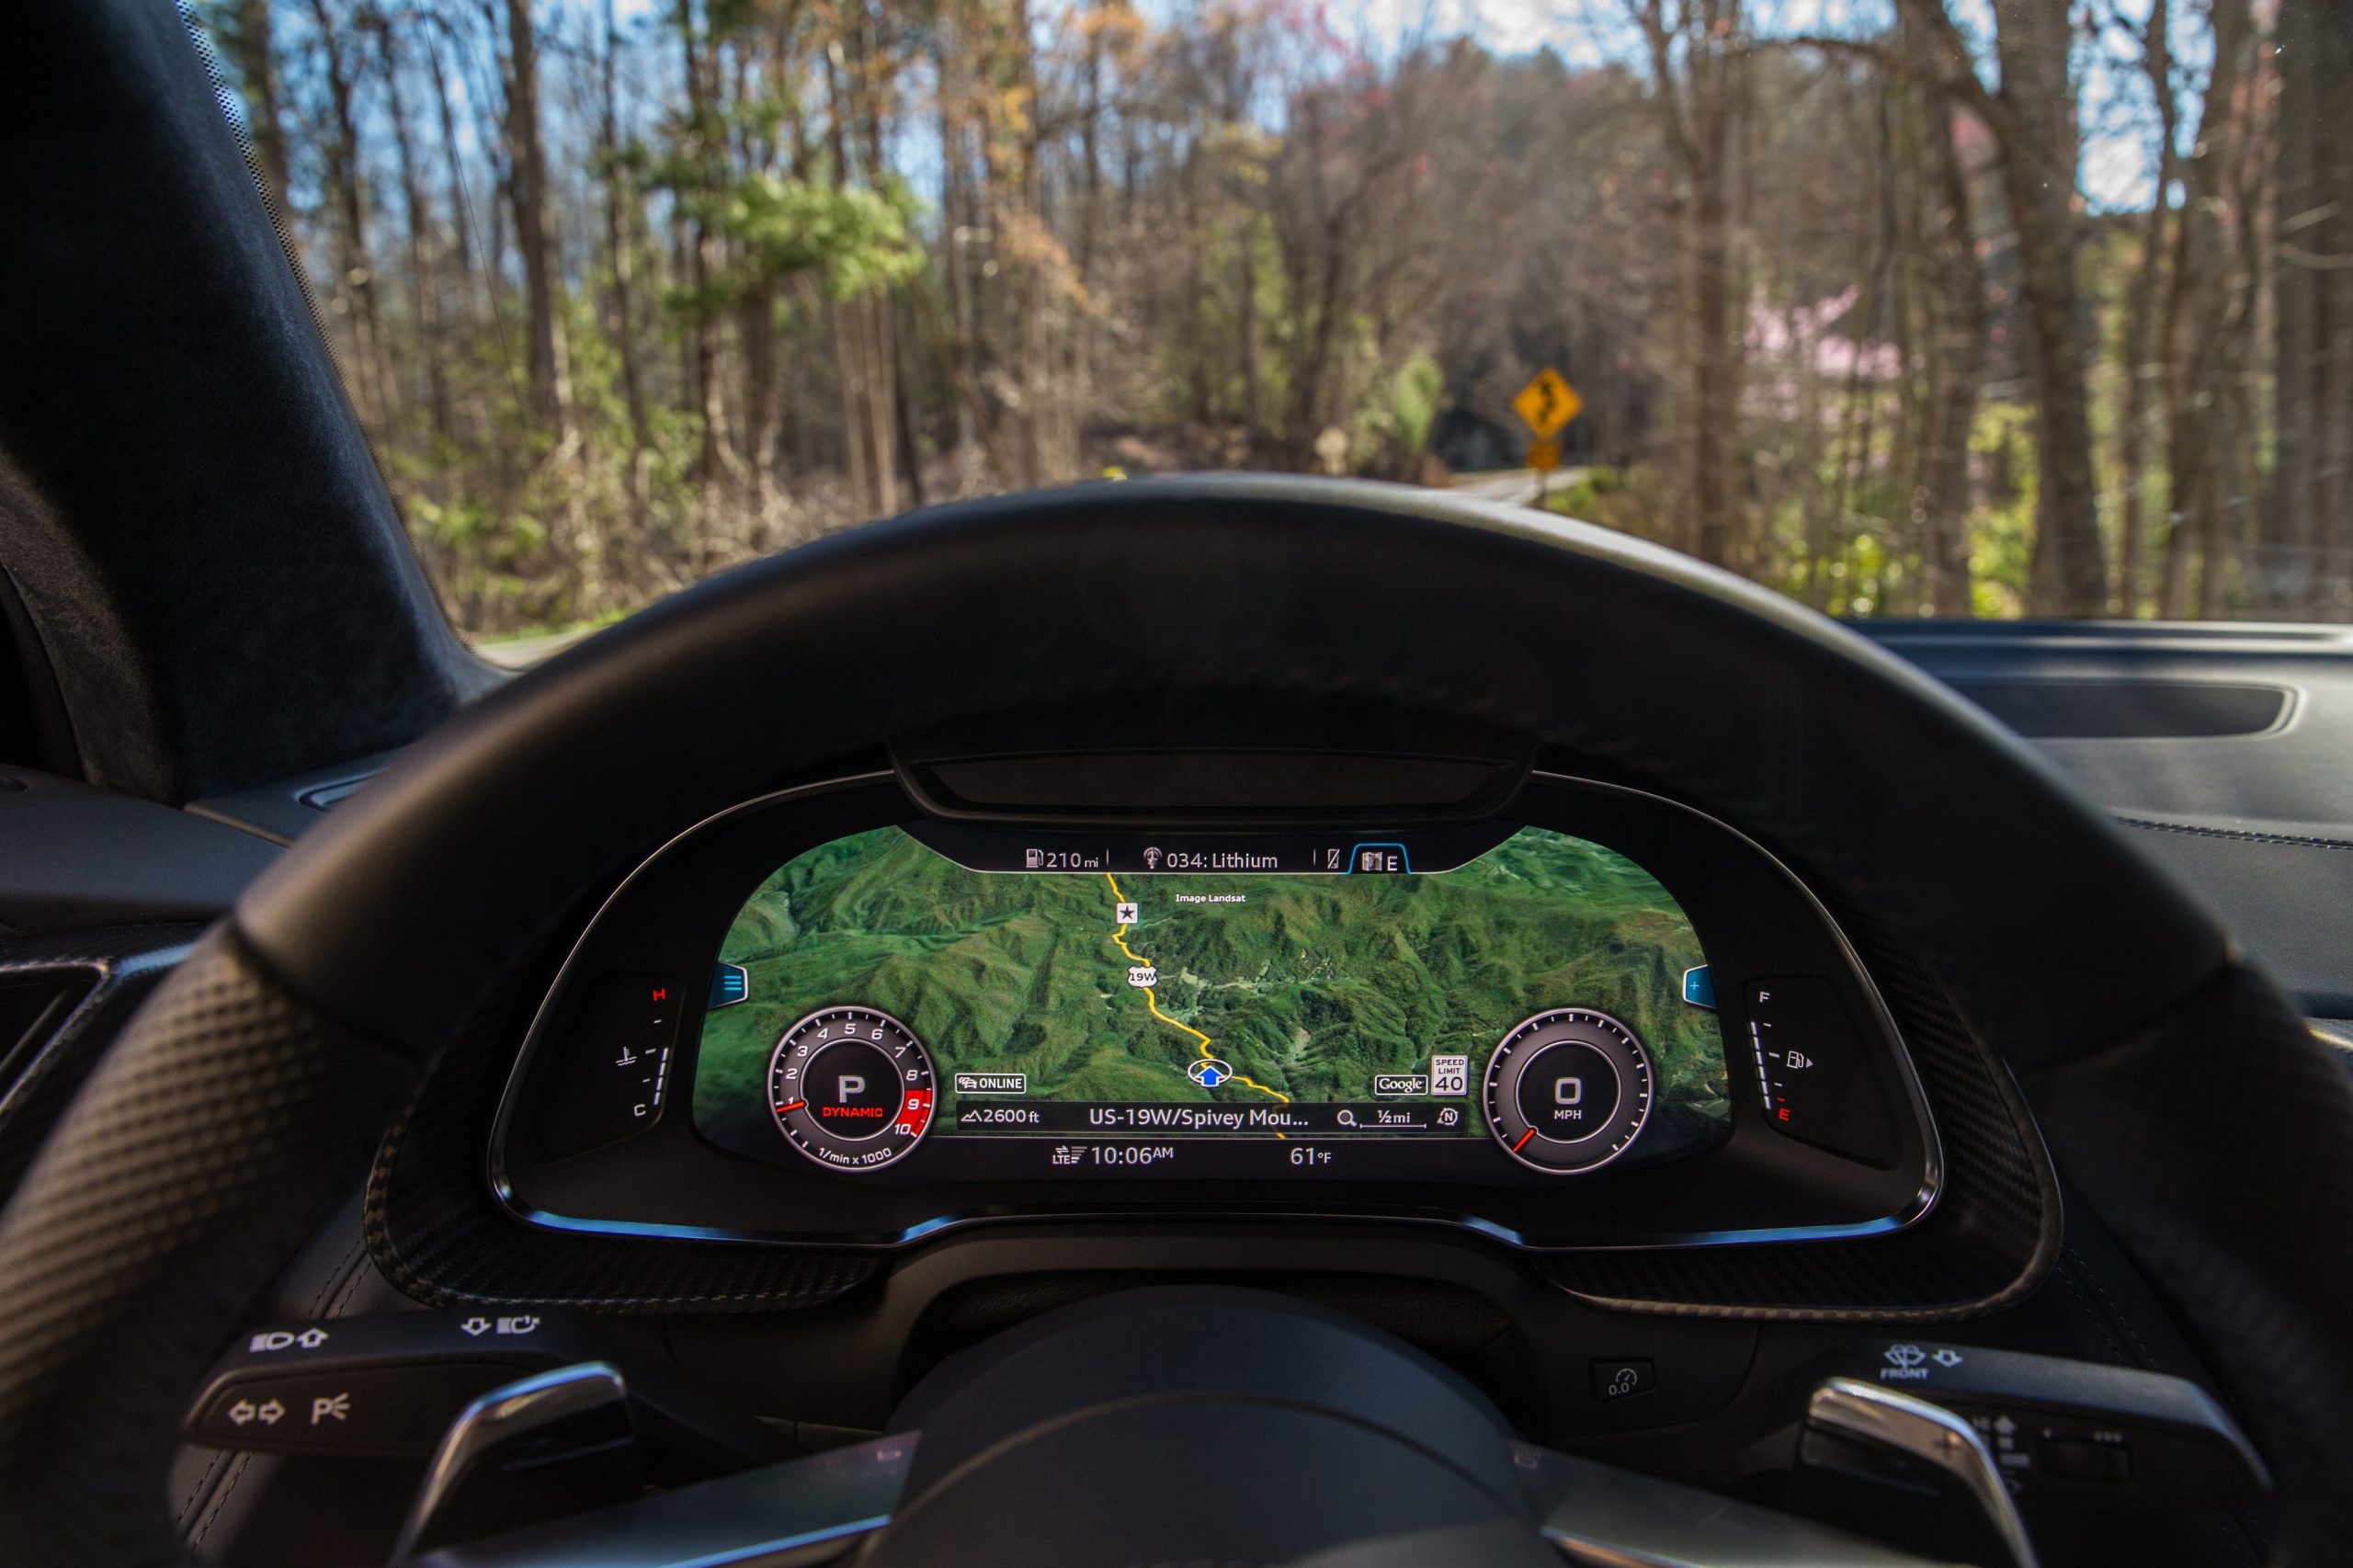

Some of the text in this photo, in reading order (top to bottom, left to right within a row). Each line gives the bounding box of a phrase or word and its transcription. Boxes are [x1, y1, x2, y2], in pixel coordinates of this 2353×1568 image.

[1046, 853, 1099, 869] 210 mi
[1166, 852, 1279, 869] 034: Lithium
[1387, 855, 1399, 871] E
[1175, 893, 1246, 903] Image Landsat
[1130, 972, 1156, 982] 19W
[652, 988, 666, 1001] H
[1758, 991, 1770, 1003] F
[816, 1028, 829, 1040] 4
[844, 1022, 857, 1035] 5
[871, 1028, 883, 1040] 6
[797, 1045, 809, 1057] 3
[894, 1046, 907, 1059] 7
[785, 1068, 798, 1080] 2
[906, 1069, 918, 1081] 8
[837, 1074, 866, 1103] P
[979, 1077, 1023, 1089] ONLINE
[1379, 1077, 1424, 1094] Google
[1434, 1076, 1463, 1092] 40
[1554, 1076, 1582, 1105] 0
[633, 1103, 646, 1117] C
[907, 1098, 920, 1110] 9
[823, 1107, 883, 1118] DYNAMIC
[983, 1108, 1040, 1123] 2600 ft
[1444, 1112, 1453, 1121] N
[1553, 1109, 1583, 1119] MPH
[1779, 1108, 1790, 1121] E
[1089, 1108, 1245, 1131] US-19W/Spivey
[894, 1122, 912, 1136] 10
[818, 1147, 850, 1165] 1/min
[862, 1147, 892, 1165] 1000
[1051, 1154, 1071, 1165] LTE
[1880, 1368, 1929, 1380] FRONT
[1608, 1382, 1630, 1396] 0.0
